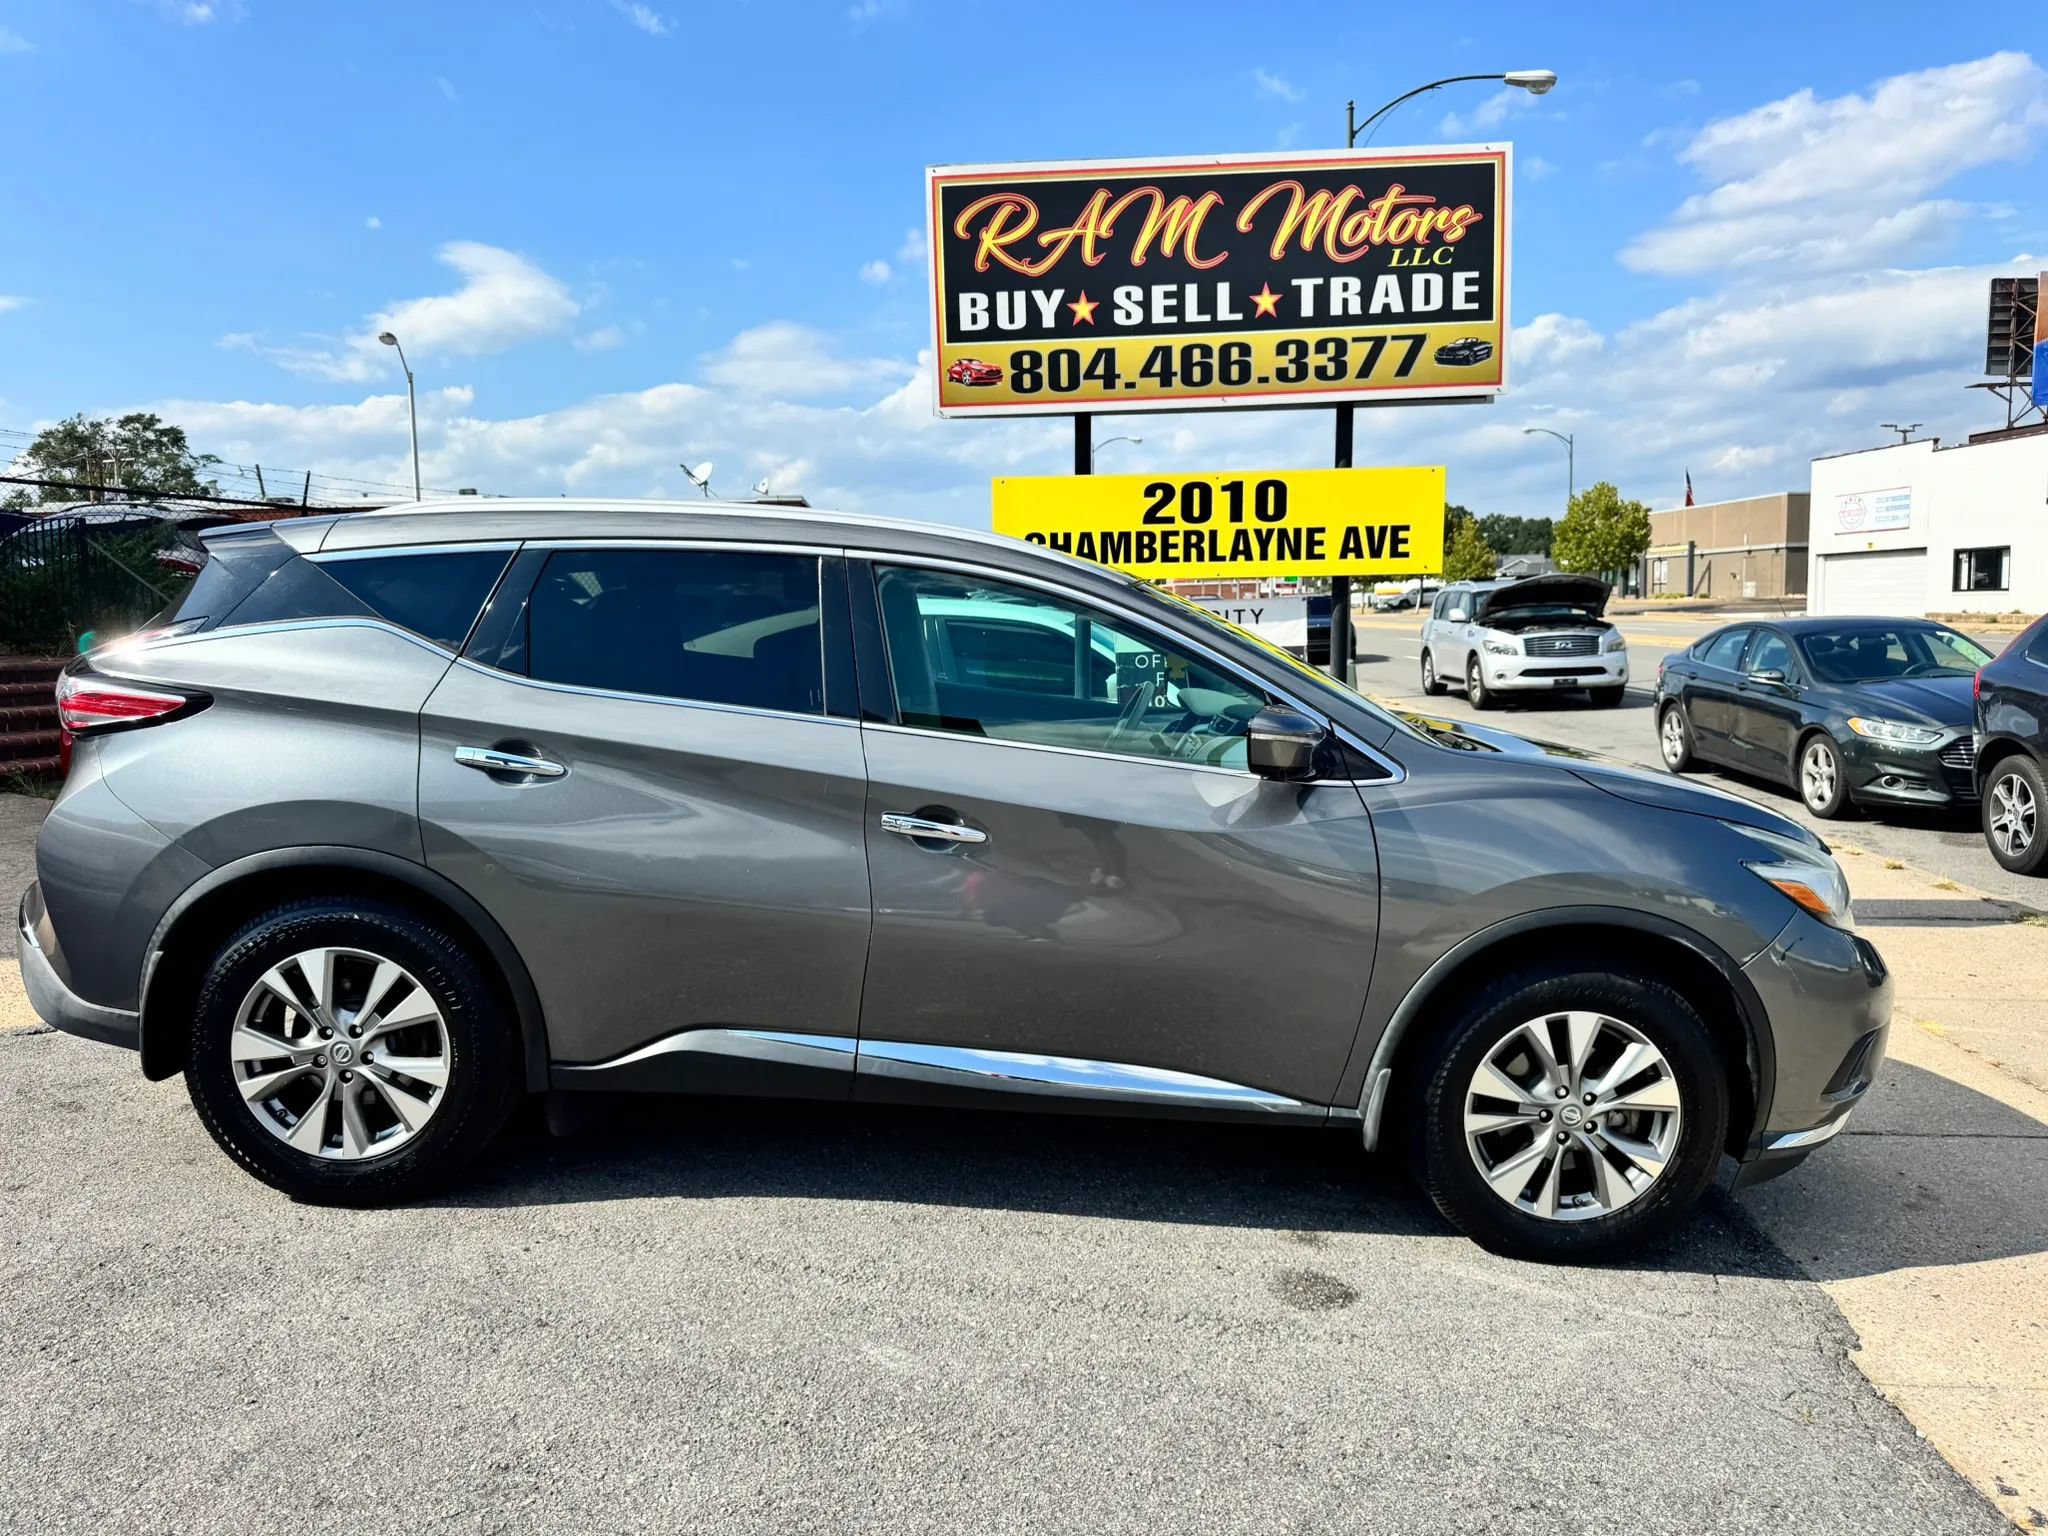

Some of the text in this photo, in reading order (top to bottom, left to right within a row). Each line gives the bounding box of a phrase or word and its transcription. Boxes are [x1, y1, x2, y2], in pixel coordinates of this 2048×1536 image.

[954, 180, 1483, 277] RAM Motors
[1387, 246, 1455, 268] LLC
[958, 271, 1480, 332] BUY SELL TRADE
[1010, 333, 1429, 395] 804.466.3377
[1142, 479, 1288, 524] 2010
[1339, 524, 1411, 560] AVE
[1211, 608, 1264, 625] ITY
